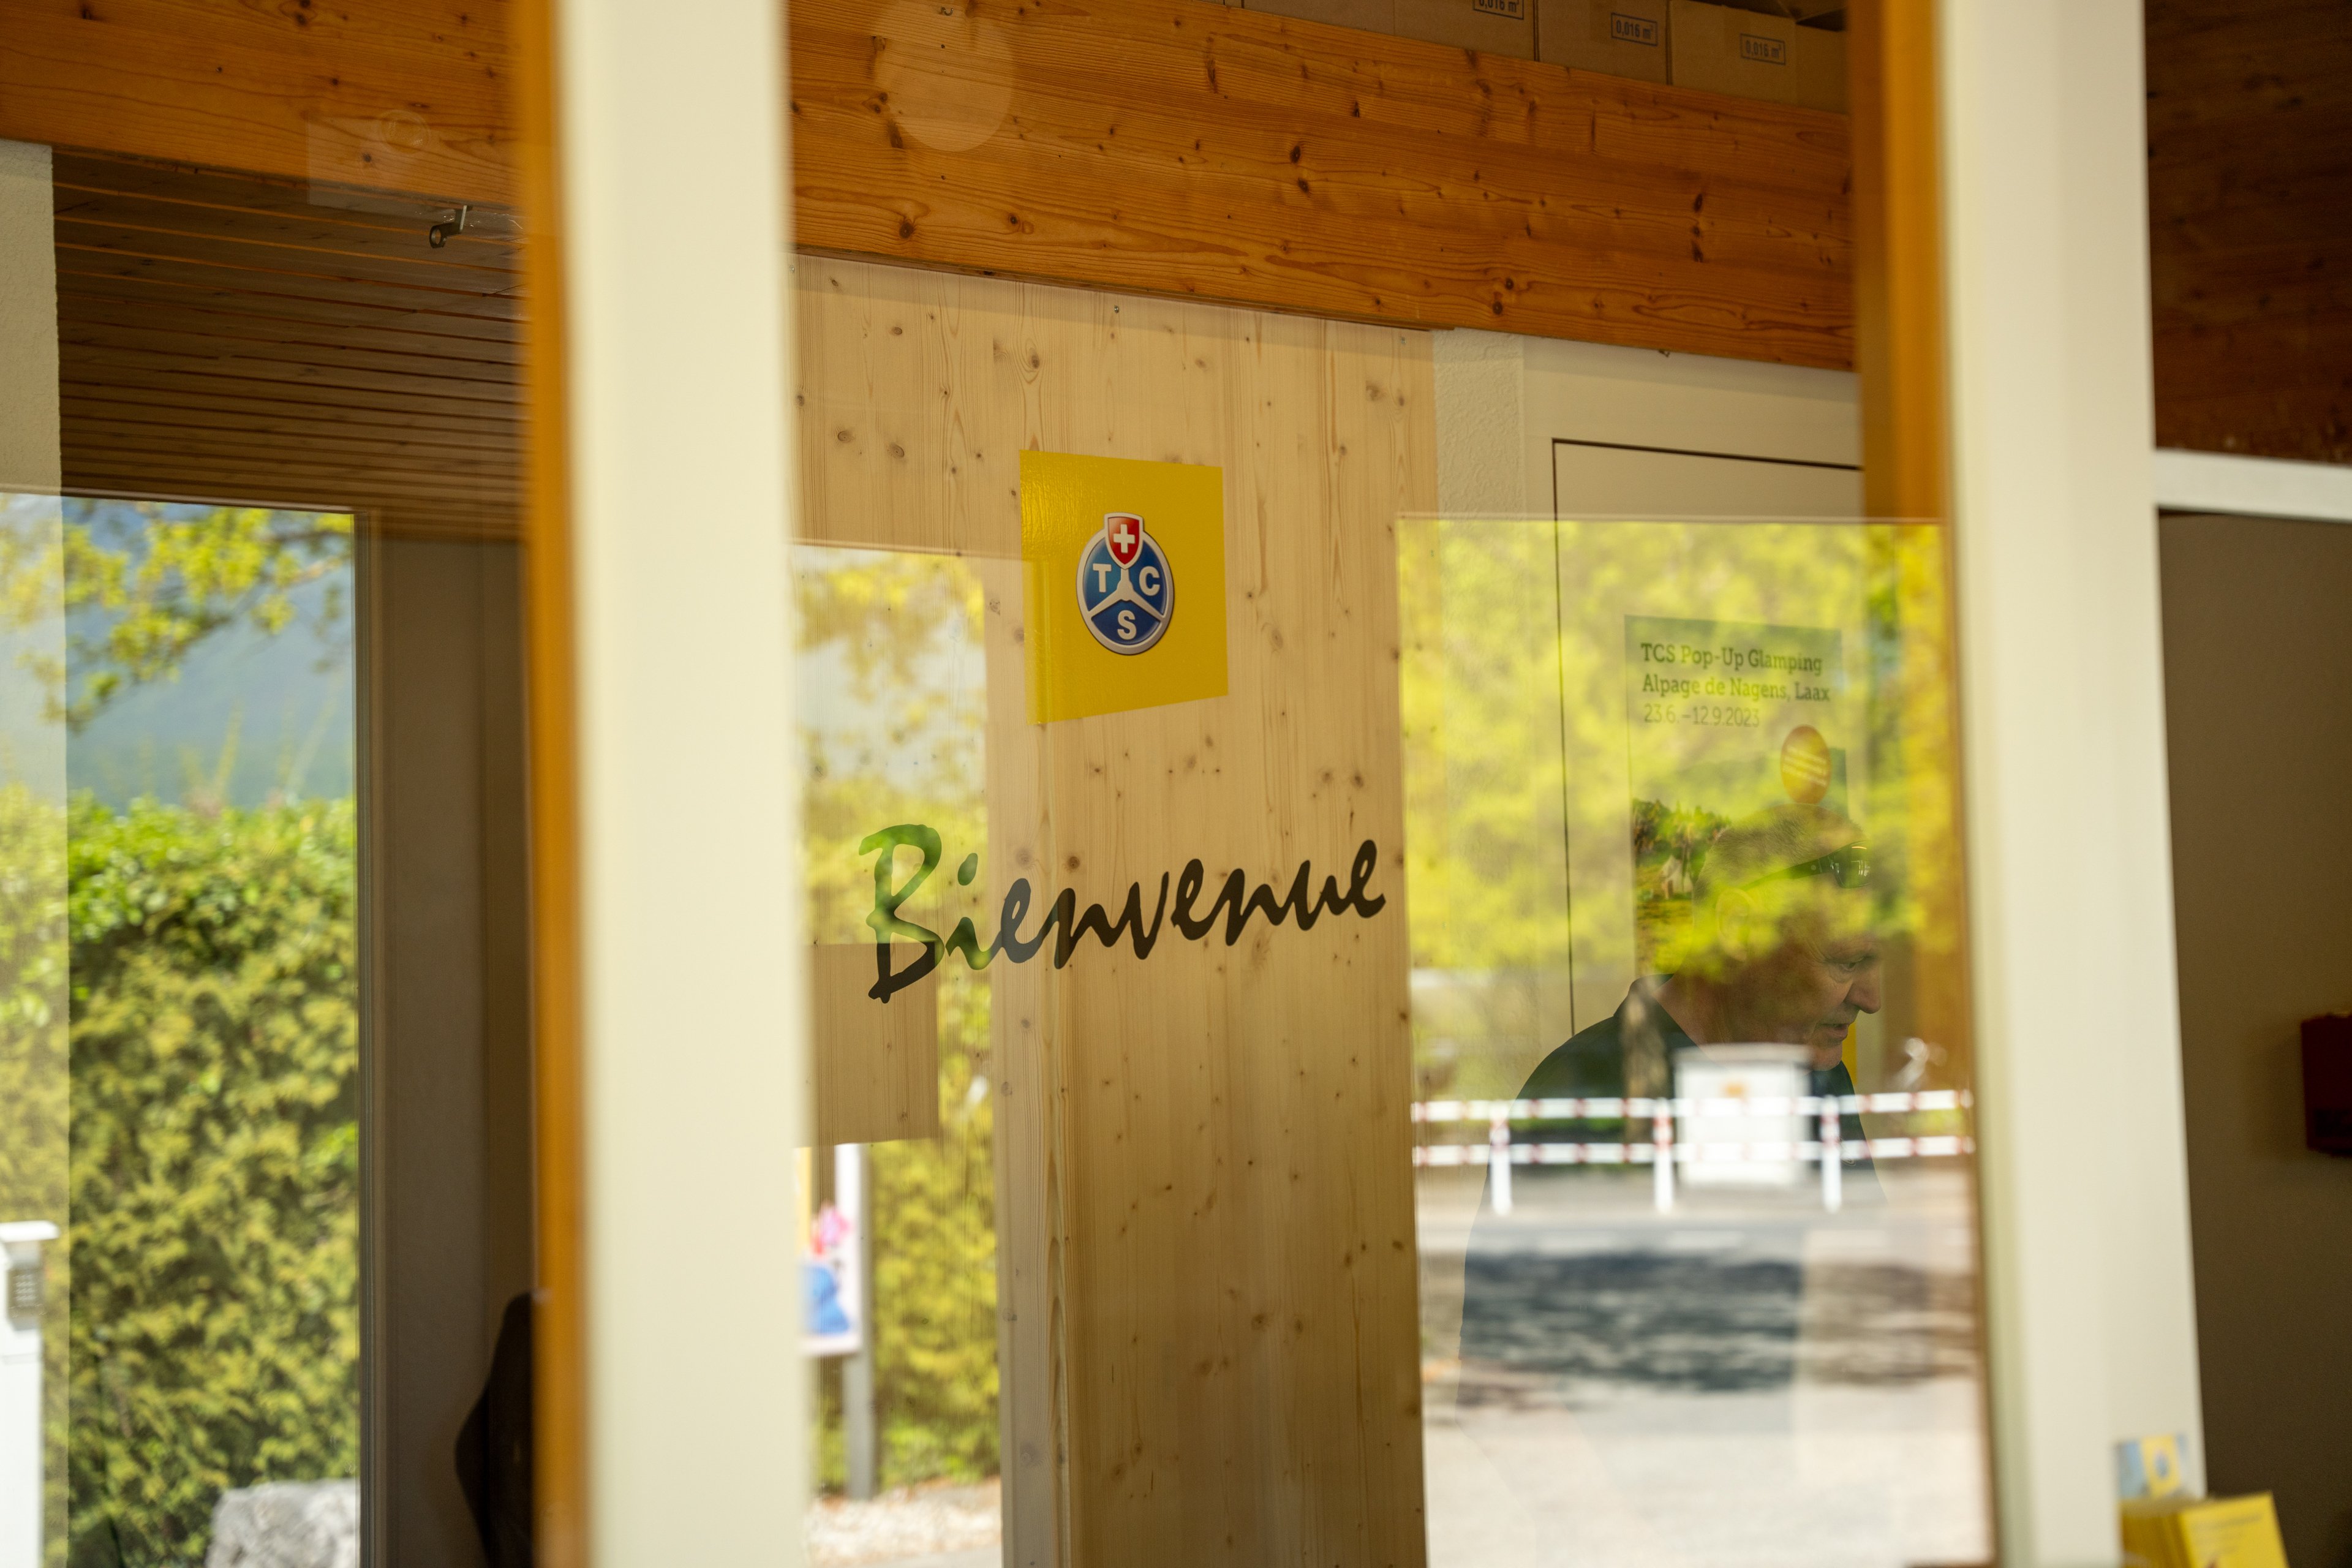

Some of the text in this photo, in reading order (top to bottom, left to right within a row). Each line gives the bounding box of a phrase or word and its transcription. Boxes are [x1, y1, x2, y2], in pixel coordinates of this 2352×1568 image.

[1616, 20, 1640, 37] 0,016
[1745, 38, 1769, 57] 0,016
[1640, 642, 1823, 677] TCS Pop-Up Glamping
[1642, 673, 1831, 703] Alpage de Nagens, Laax
[858, 823, 1387, 1004] Bienvenue
